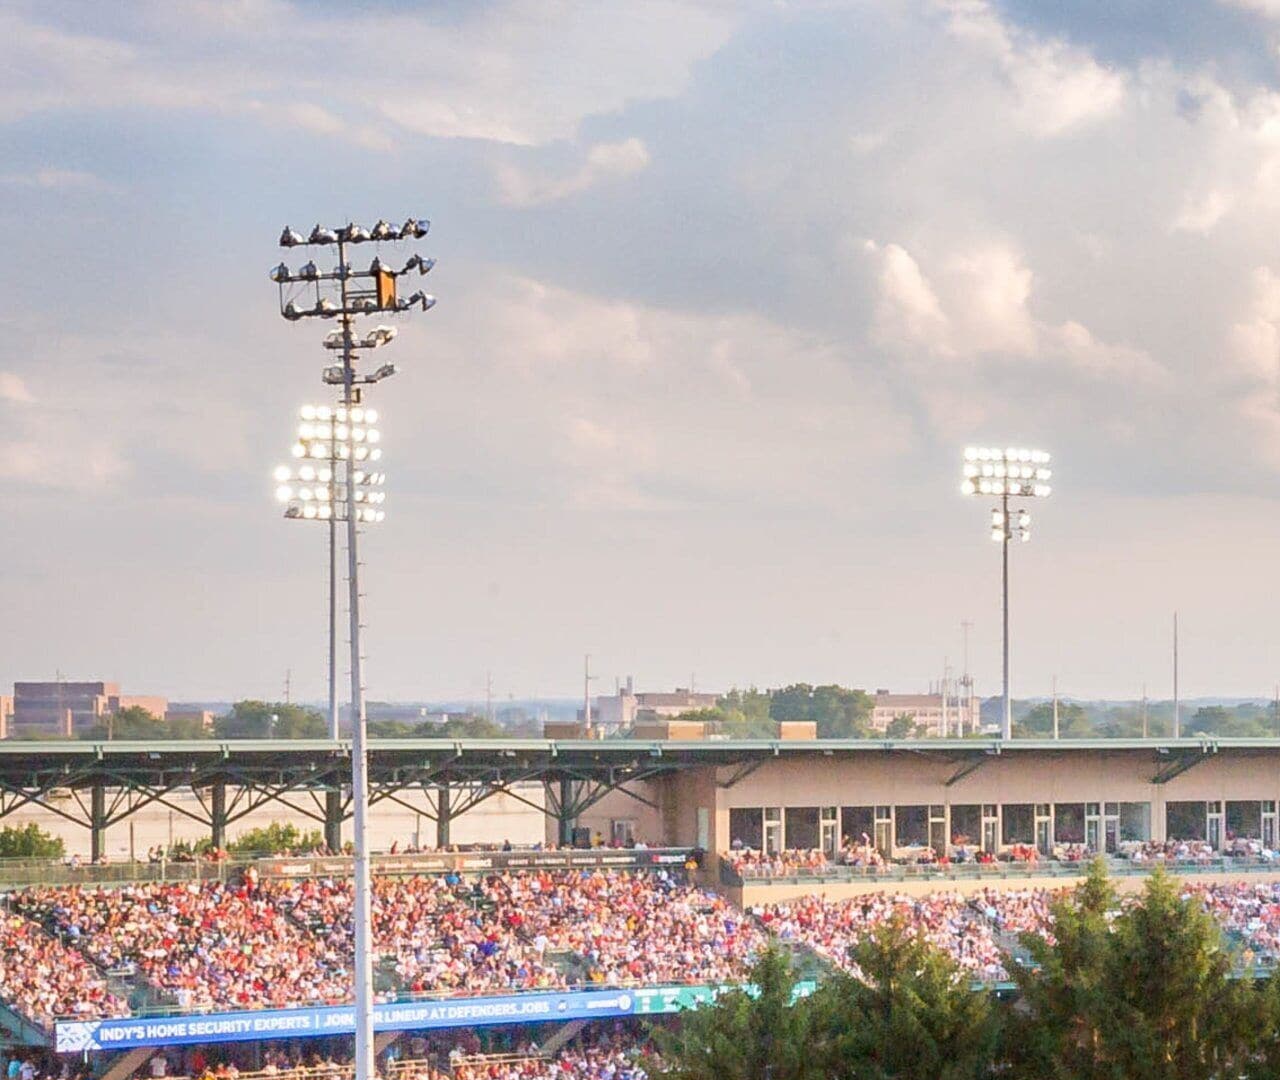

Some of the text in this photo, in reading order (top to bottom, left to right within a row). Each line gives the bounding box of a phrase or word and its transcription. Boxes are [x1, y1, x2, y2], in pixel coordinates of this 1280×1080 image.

[384, 1008, 428, 1024] LINEUP
[430, 1007, 446, 1020] AT
[448, 1001, 550, 1019] DEFENDERS.JOBS
[101, 1025, 145, 1041] INDY'S
[147, 1023, 186, 1038] HOME
[188, 1019, 251, 1036] SECURITY
[254, 1016, 310, 1032] EXPERTS
